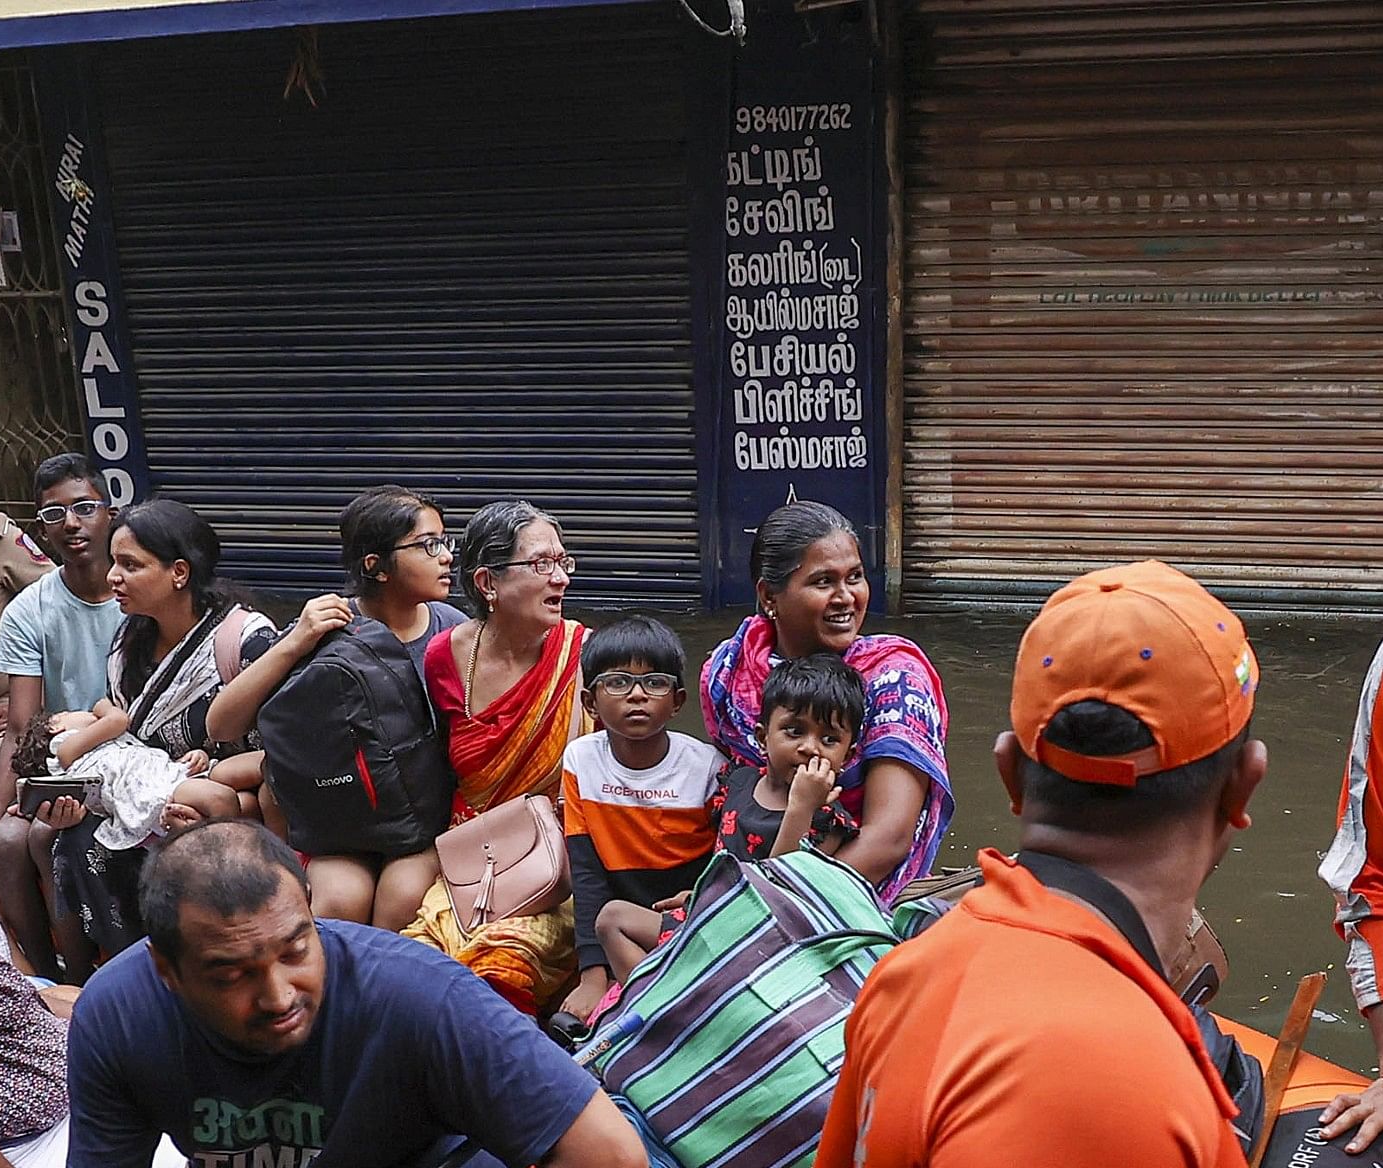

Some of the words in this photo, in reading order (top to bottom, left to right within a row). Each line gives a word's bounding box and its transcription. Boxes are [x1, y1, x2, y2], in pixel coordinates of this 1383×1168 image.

[735, 103, 852, 133] 9840177262
[726, 185, 835, 237] சேவிங்
[730, 332, 856, 377] பேசியல்
[315, 774, 354, 787] Lenovo
